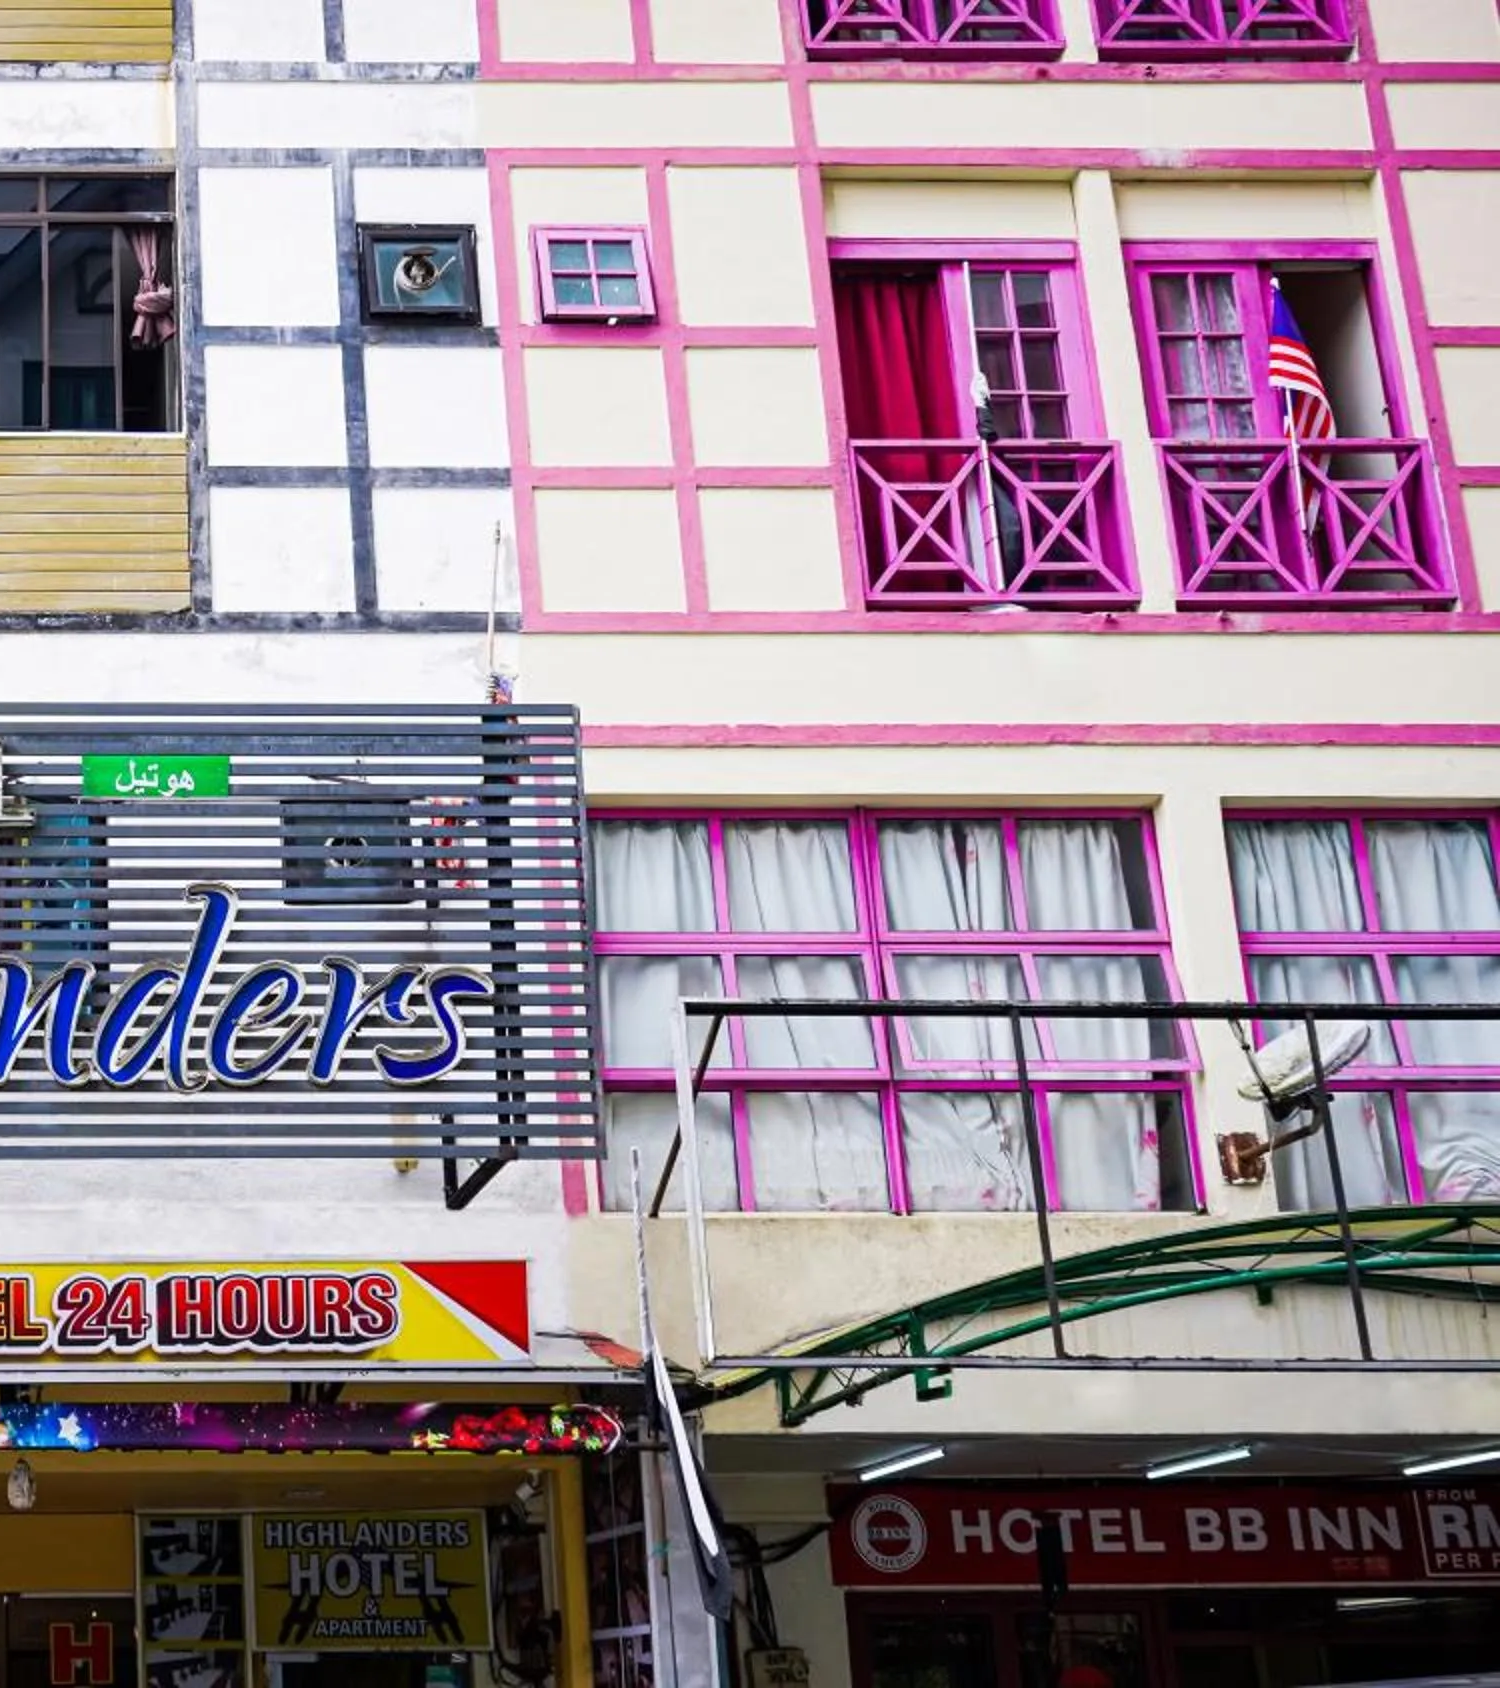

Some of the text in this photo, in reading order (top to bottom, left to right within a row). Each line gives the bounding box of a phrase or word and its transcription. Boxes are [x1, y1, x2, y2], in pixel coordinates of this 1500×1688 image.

[114, 761, 196, 797] هوتيل
[62, 1277, 152, 1341] 24
[172, 1276, 397, 1339] HOURS
[1424, 1488, 1477, 1502] FROM
[265, 1520, 470, 1548] HIGHLANDERS
[949, 1505, 1404, 1554] HOTEL BB INN
[288, 1552, 450, 1598] HOTEL
[1434, 1552, 1482, 1570] PER
[364, 1599, 381, 1616] &
[315, 1618, 428, 1638] APARTMENT
